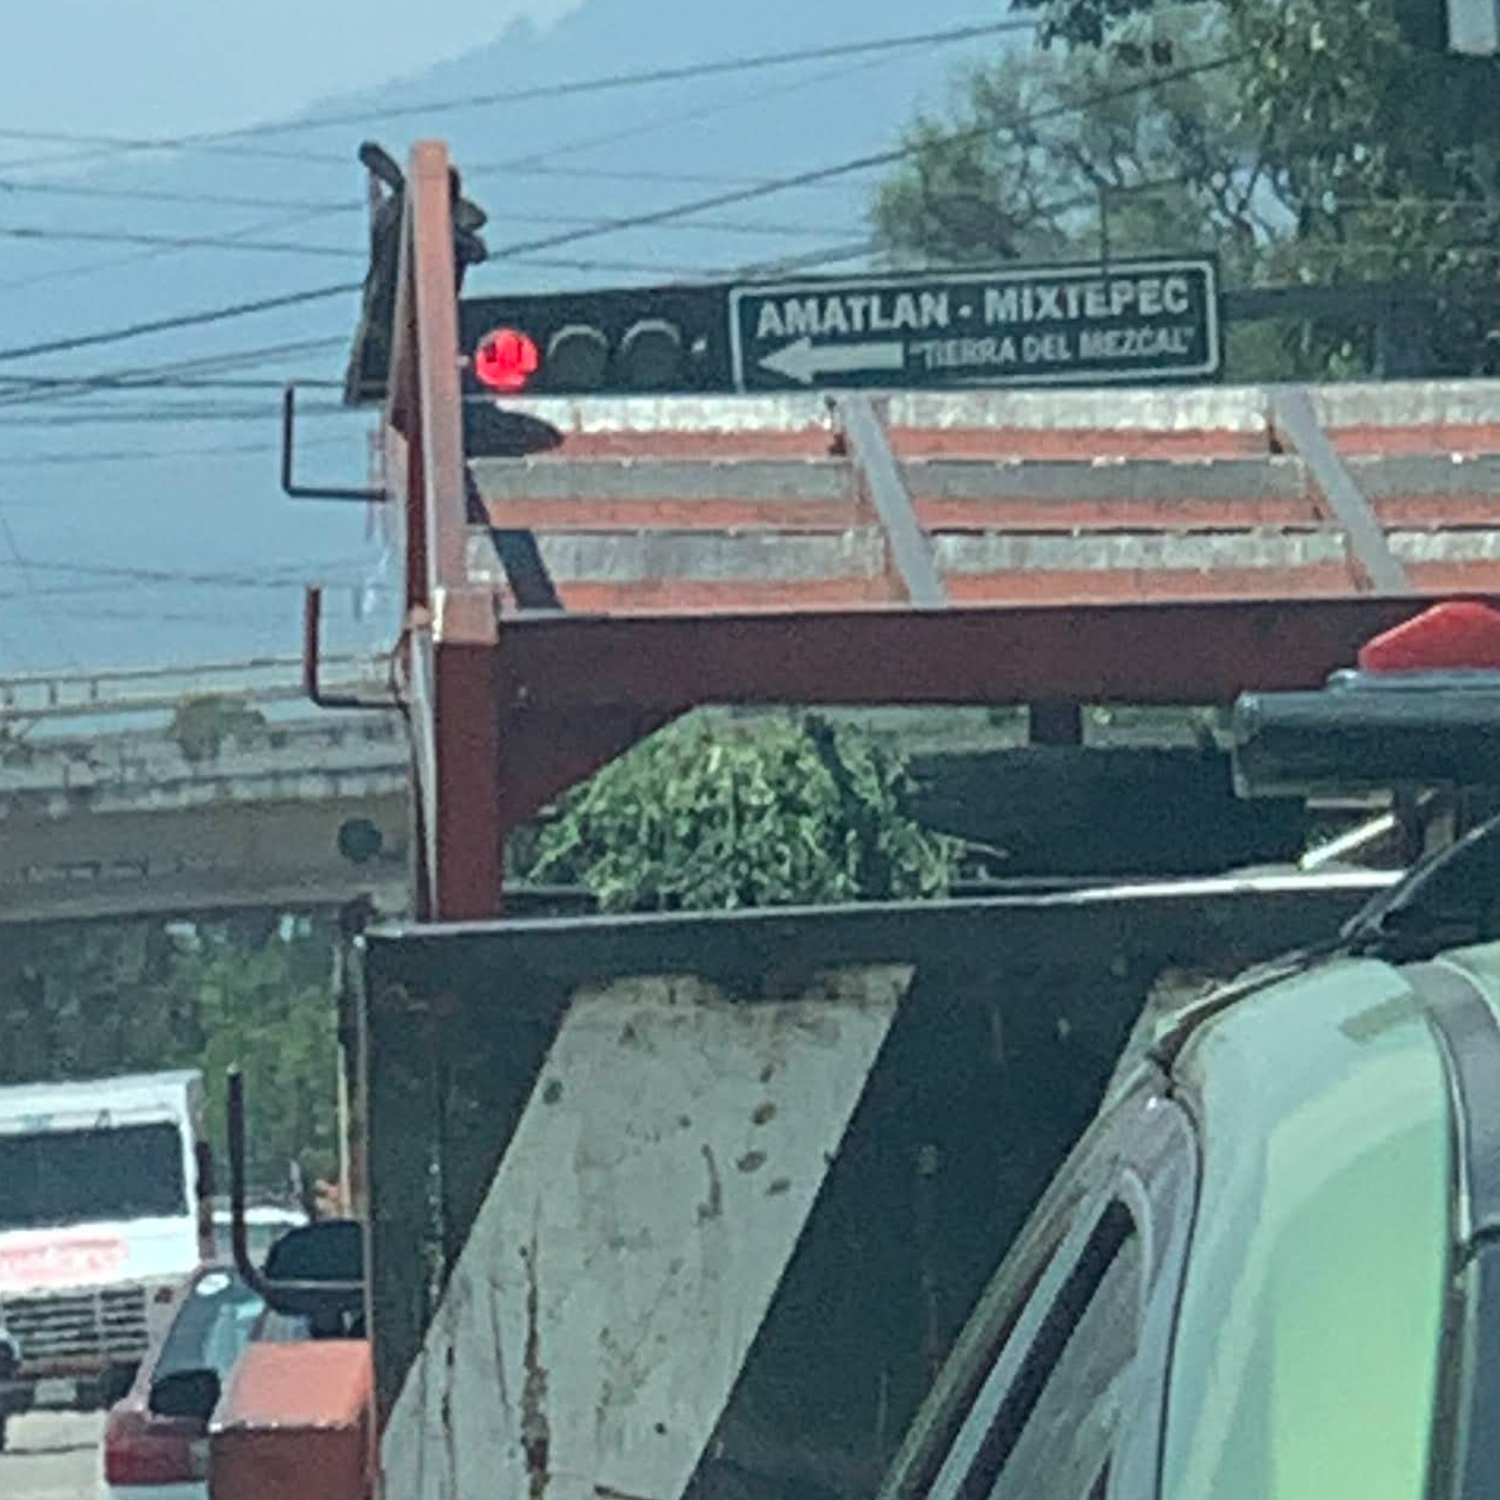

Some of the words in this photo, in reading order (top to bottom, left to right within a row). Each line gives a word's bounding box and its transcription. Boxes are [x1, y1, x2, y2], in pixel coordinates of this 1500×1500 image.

[756, 290, 951, 339] AMATLAN
[984, 277, 1190, 325] MIXTEPEC
[1023, 331, 1072, 361] DEL
